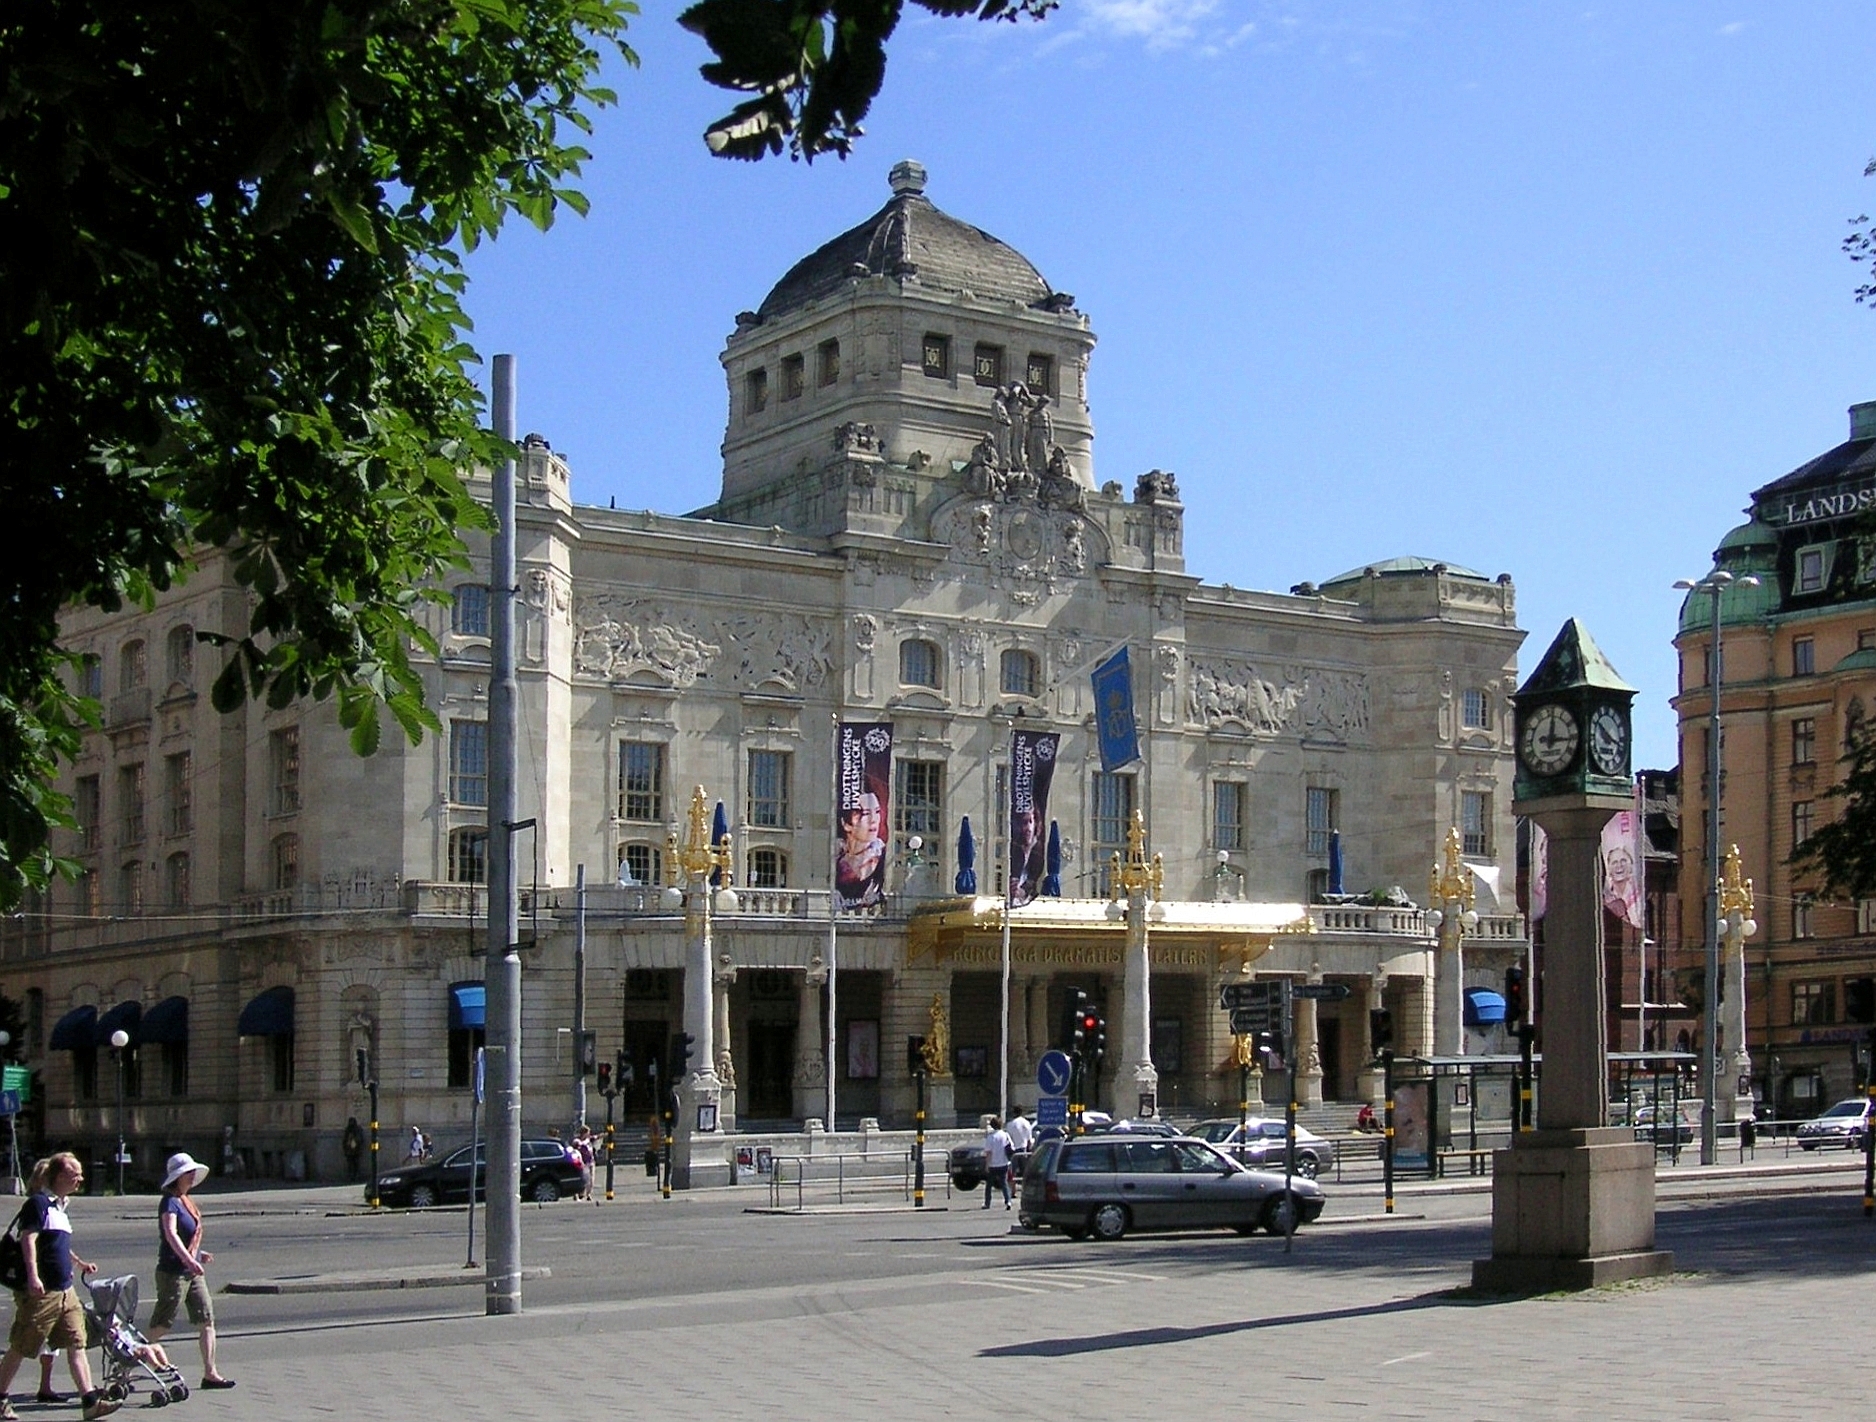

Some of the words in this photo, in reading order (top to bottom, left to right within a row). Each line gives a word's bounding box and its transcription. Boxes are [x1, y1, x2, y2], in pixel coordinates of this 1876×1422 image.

[843, 728, 853, 810] DROTTNINGENS
[852, 739, 861, 810] JUVELSMYCKE
[1016, 735, 1026, 813] DROTTNINGENS
[1022, 746, 1033, 813] JUVELSMYCKE
[953, 945, 1038, 962] KUNGIGA
